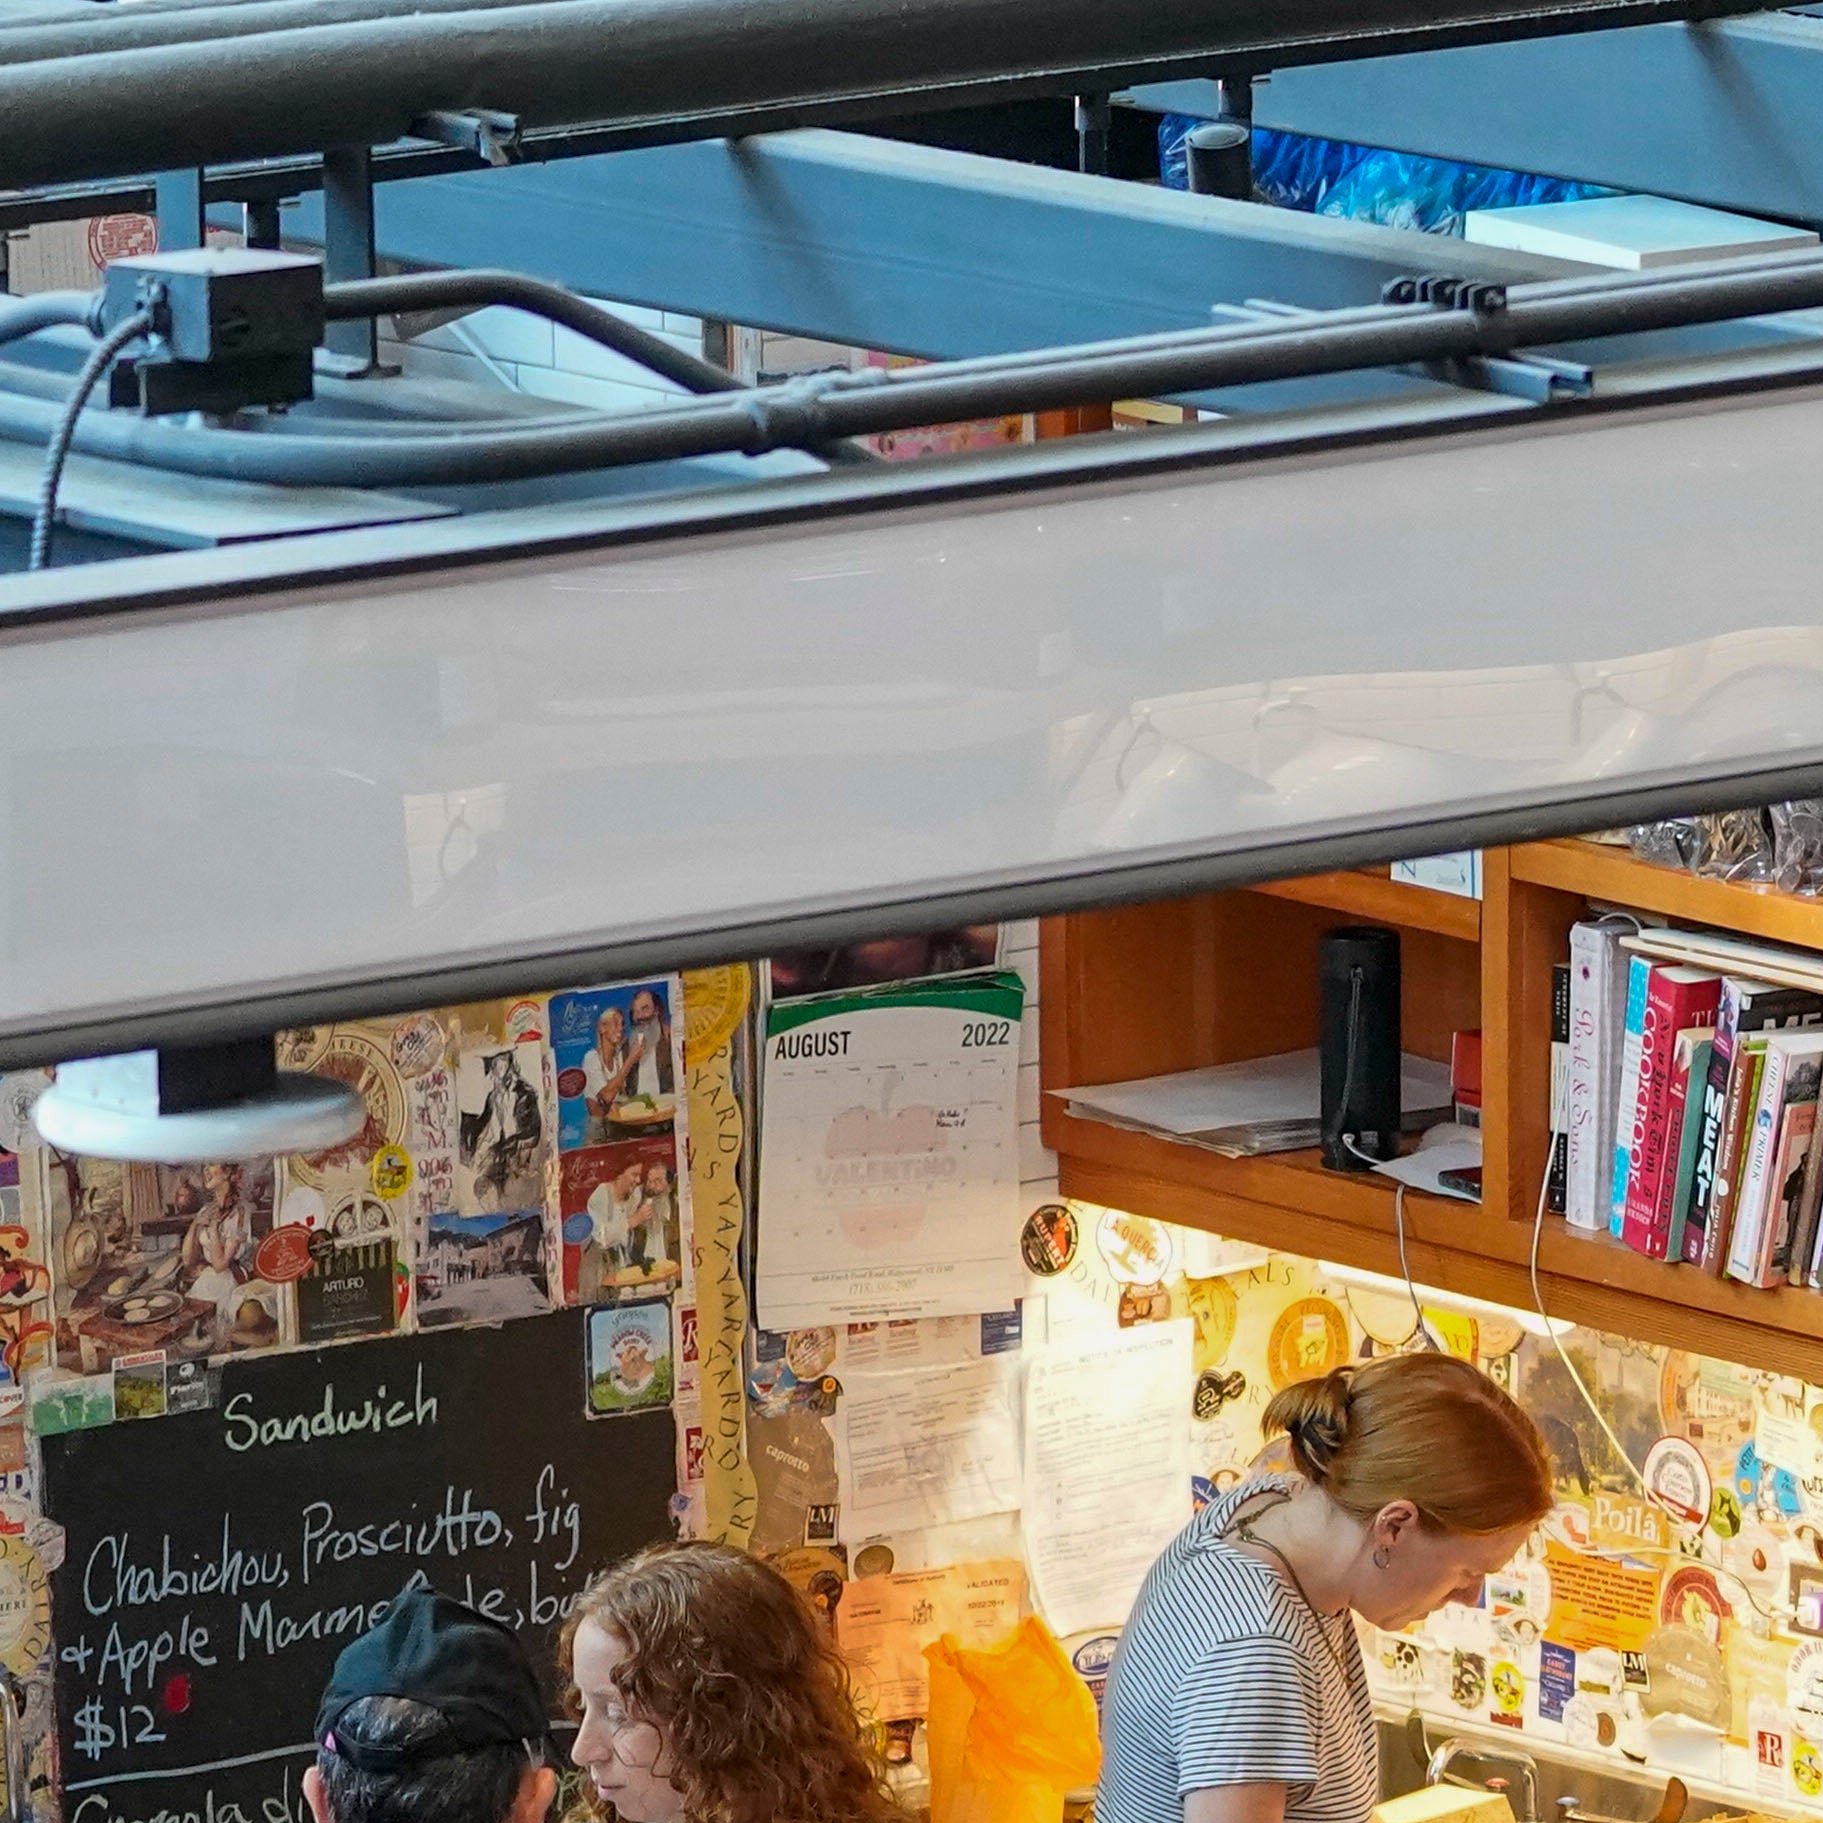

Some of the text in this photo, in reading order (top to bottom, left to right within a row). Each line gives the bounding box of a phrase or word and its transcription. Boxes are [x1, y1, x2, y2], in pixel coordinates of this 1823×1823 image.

[774, 1022, 1011, 1061] AUGUST 2022
[1627, 1006, 1657, 1191] COOKBOOK
[1696, 1084, 1724, 1207] MEAT
[322, 1276, 365, 1293] ARTURO
[223, 1361, 438, 1452] Sandwich
[83, 1463, 582, 1616] Chabichou, Prosciutto, fig
[1592, 1497, 1660, 1545] Poilâ
[98, 1620, 217, 1695] Apple
[1622, 1653, 1647, 1671] LM
[73, 1699, 169, 1761] $12
